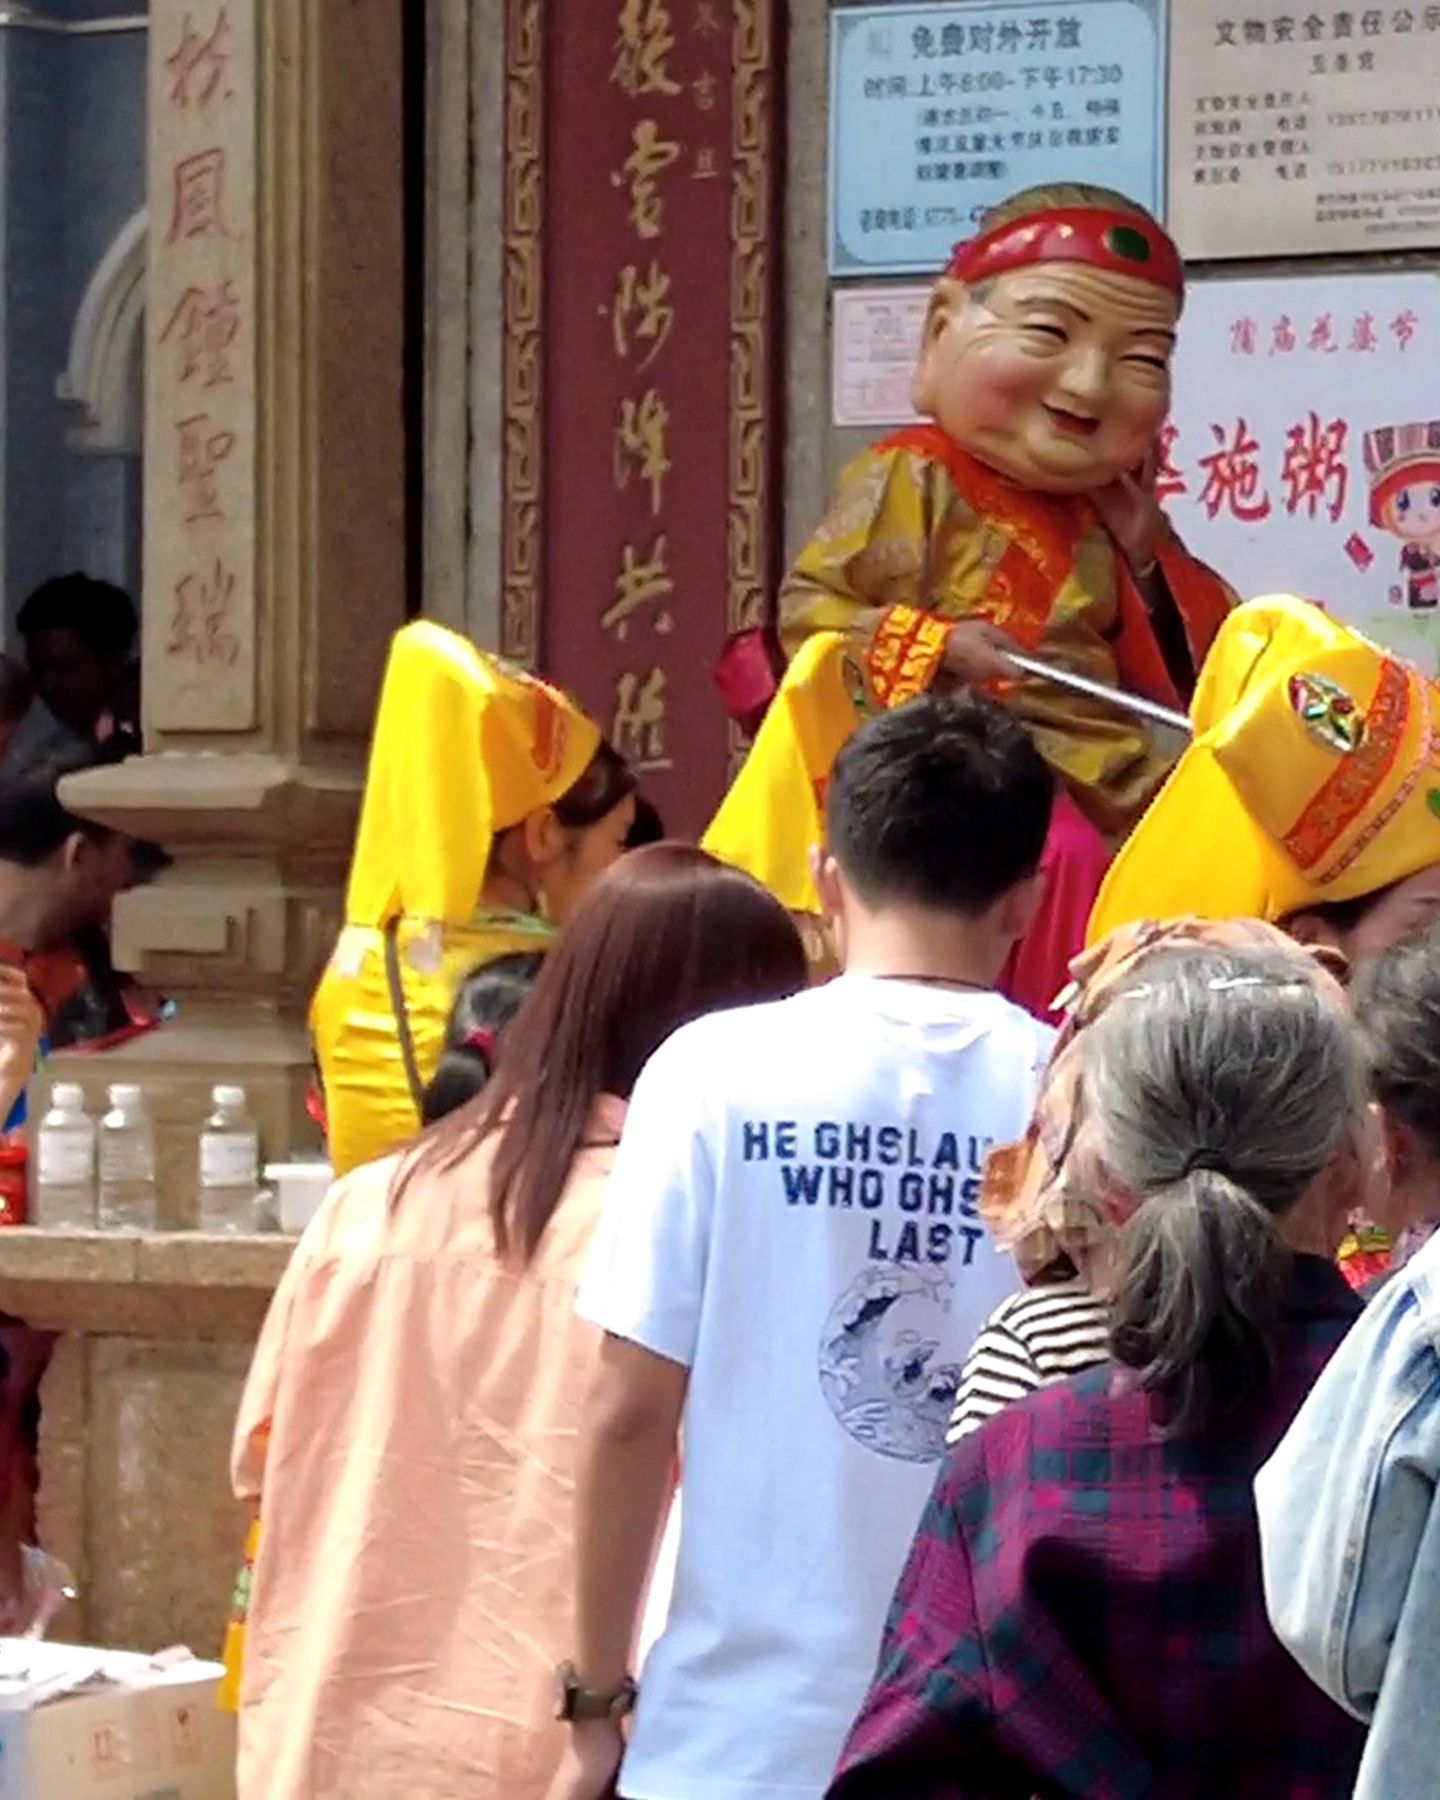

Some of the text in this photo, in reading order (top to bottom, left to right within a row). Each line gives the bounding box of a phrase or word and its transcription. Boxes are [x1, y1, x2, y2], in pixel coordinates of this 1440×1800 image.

[911, 15, 1083, 60] 免费对外开放
[743, 1120, 798, 1162] HE
[782, 1165, 883, 1209] WHO
[867, 1219, 984, 1265] LAST
